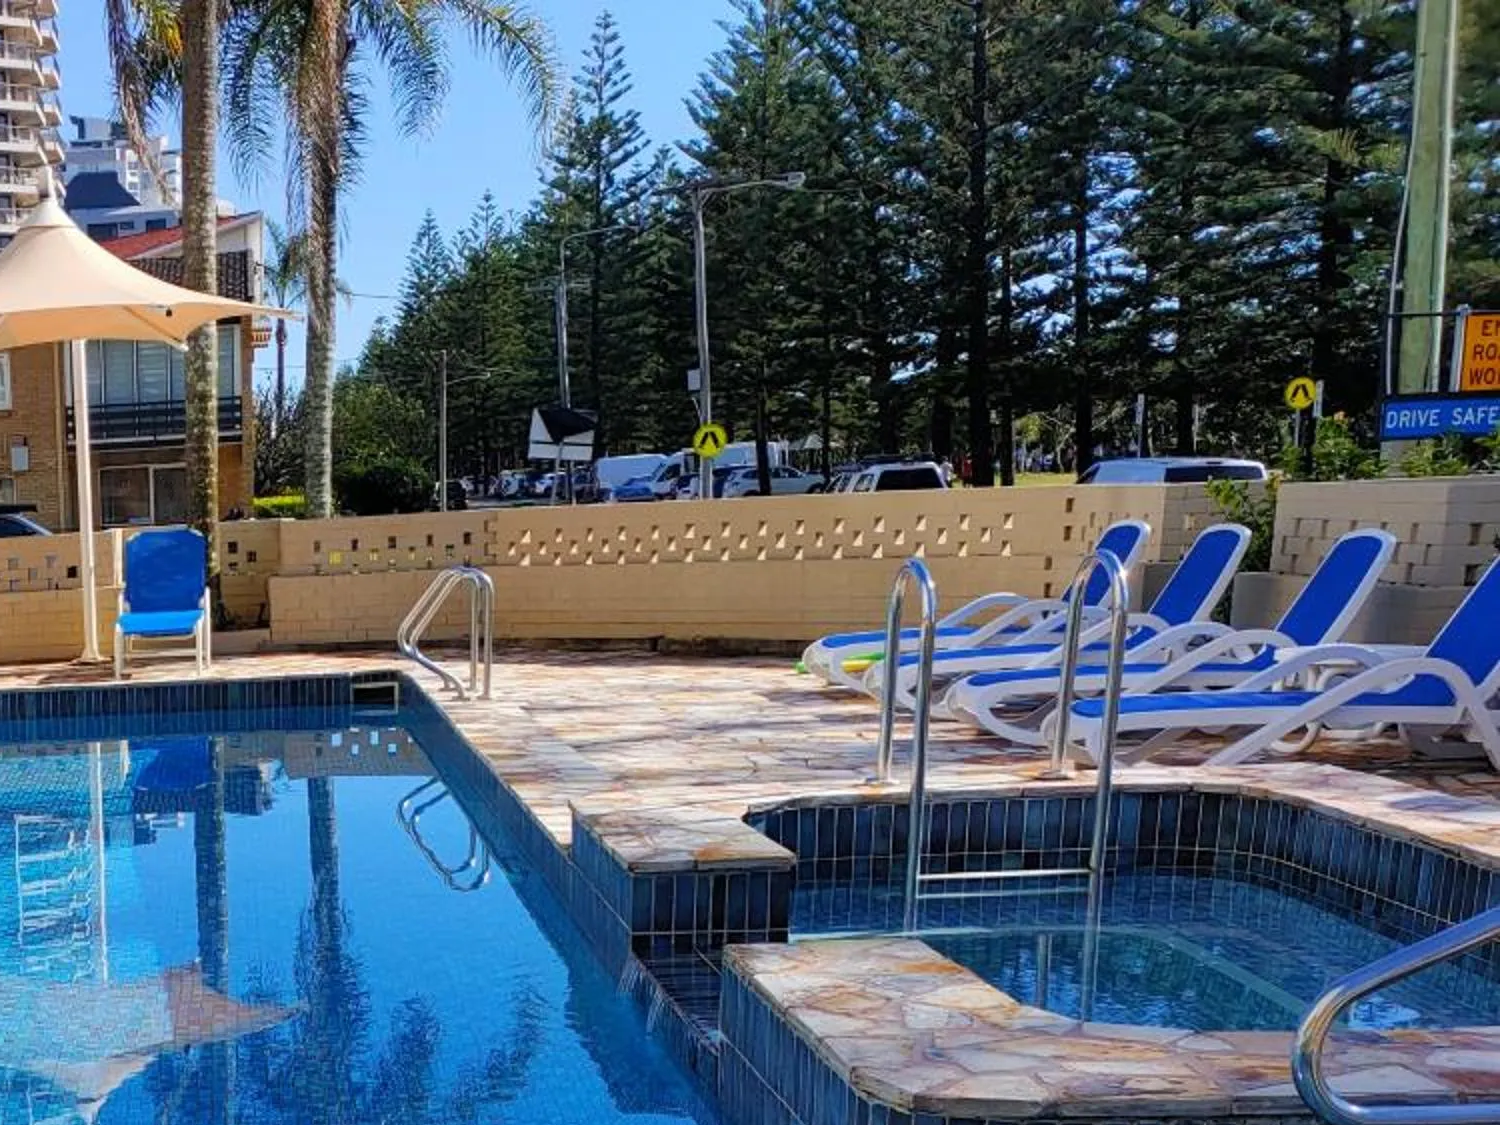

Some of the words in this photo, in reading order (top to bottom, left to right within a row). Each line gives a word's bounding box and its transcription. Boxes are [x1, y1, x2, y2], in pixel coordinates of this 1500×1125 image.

[1473, 343, 1500, 361] RO
[1469, 367, 1500, 385] WO
[1385, 409, 1441, 429] DRIVE
[1451, 406, 1500, 425] SAFE
